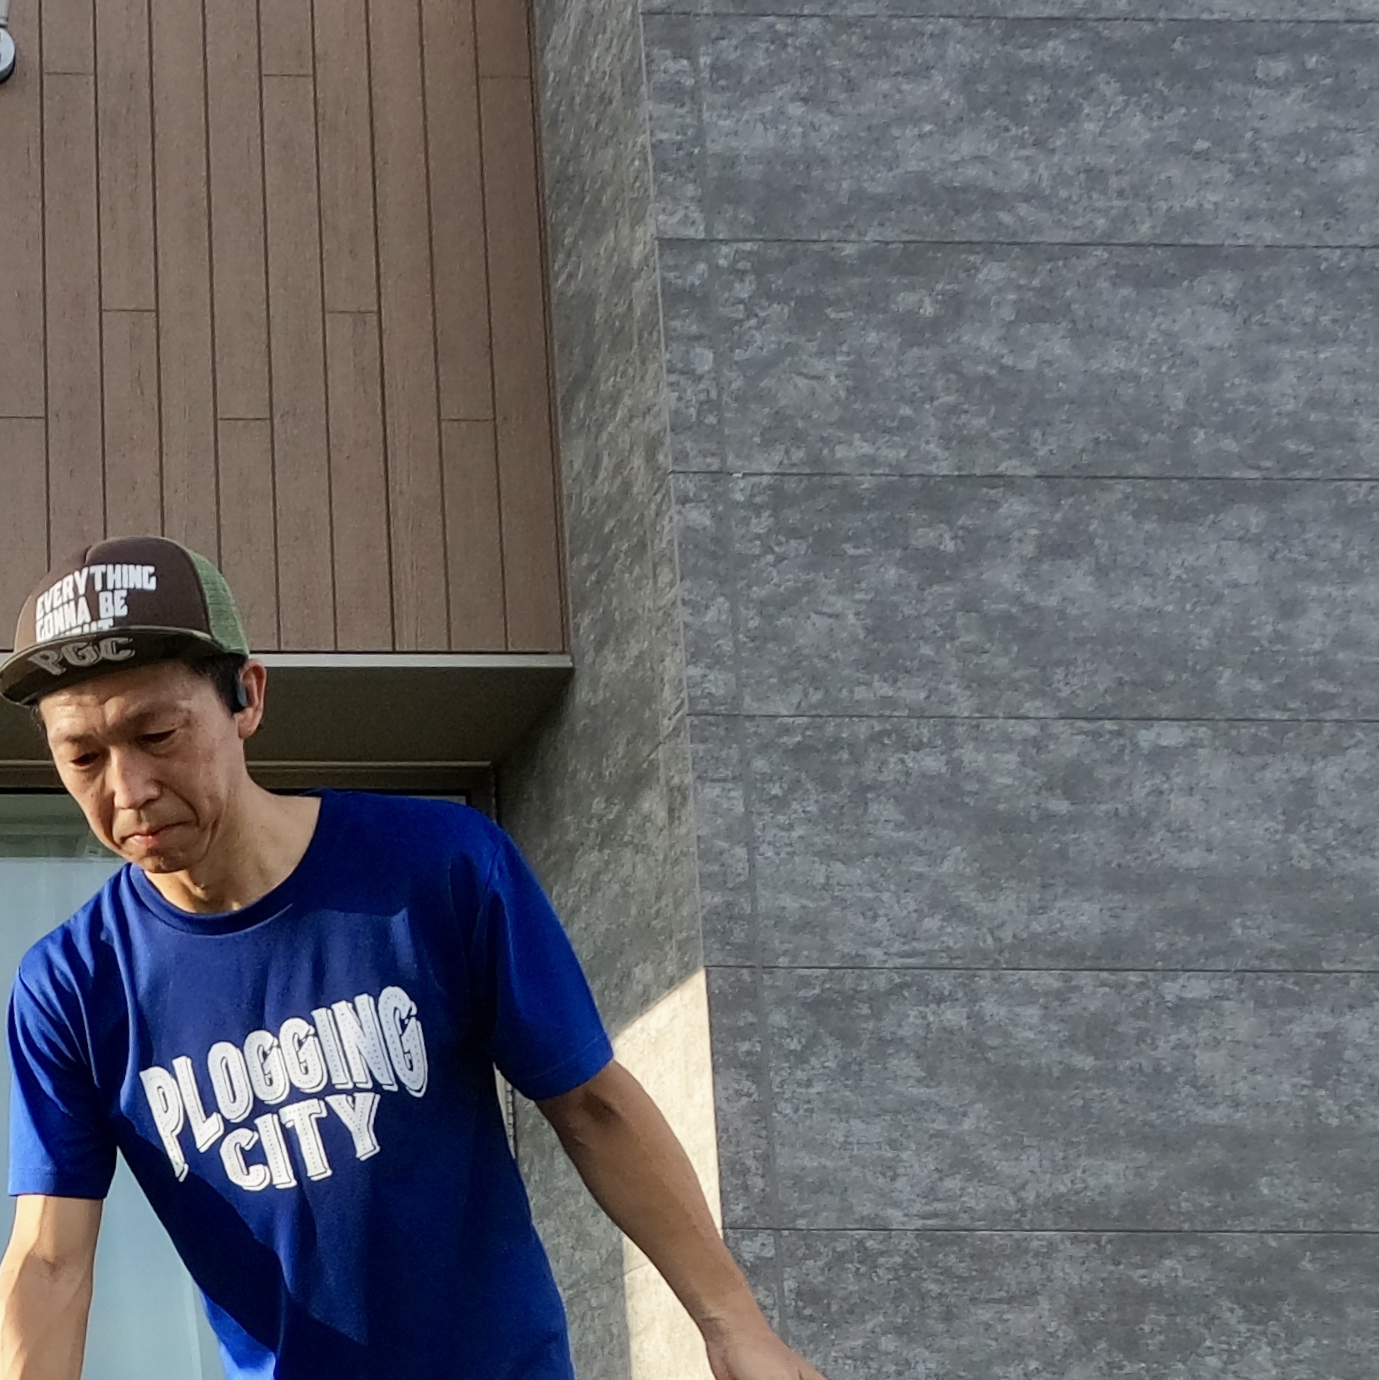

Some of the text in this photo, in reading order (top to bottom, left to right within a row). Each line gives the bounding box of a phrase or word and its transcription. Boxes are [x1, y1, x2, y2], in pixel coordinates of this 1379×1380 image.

[35, 563, 157, 622] EVERYTHING
[35, 595, 92, 643] GONNA
[98, 589, 129, 620] BE
[27, 636, 136, 676] PGC
[139, 985, 429, 1182] PLOGGING
[220, 1092, 381, 1191] CITY
